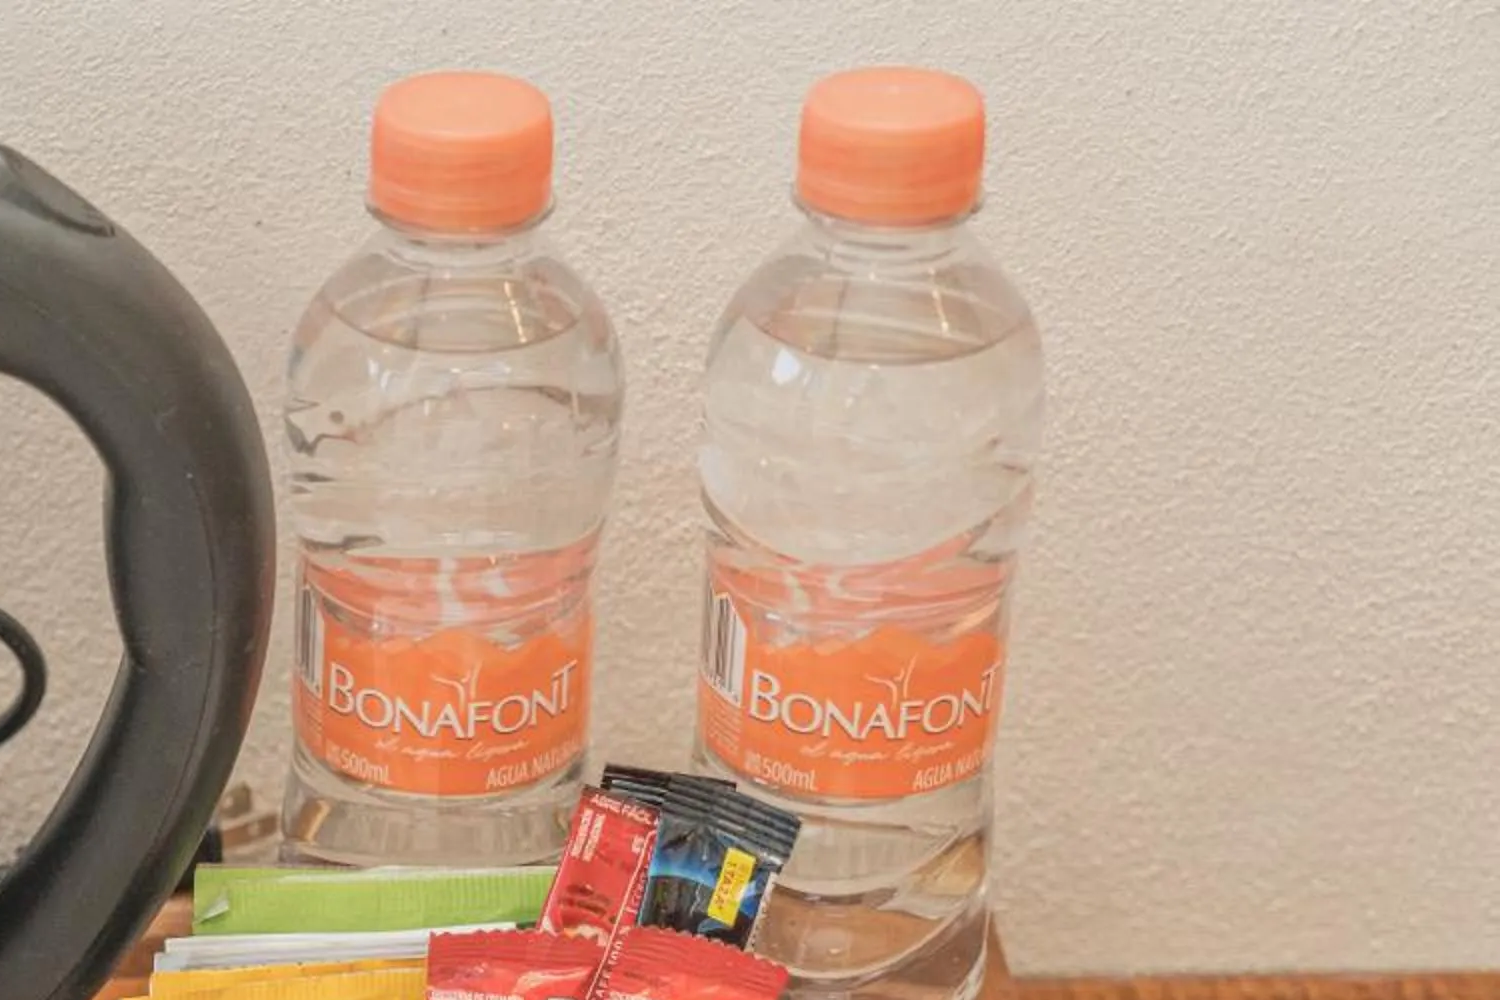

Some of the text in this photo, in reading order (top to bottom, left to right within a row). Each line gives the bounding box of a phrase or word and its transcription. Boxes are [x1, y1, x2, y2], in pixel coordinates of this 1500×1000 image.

[329, 659, 577, 739] BONAFONT
[749, 661, 1001, 740] BONAFONT
[485, 764, 528, 790] AGUA
[912, 762, 951, 791] AGUA
